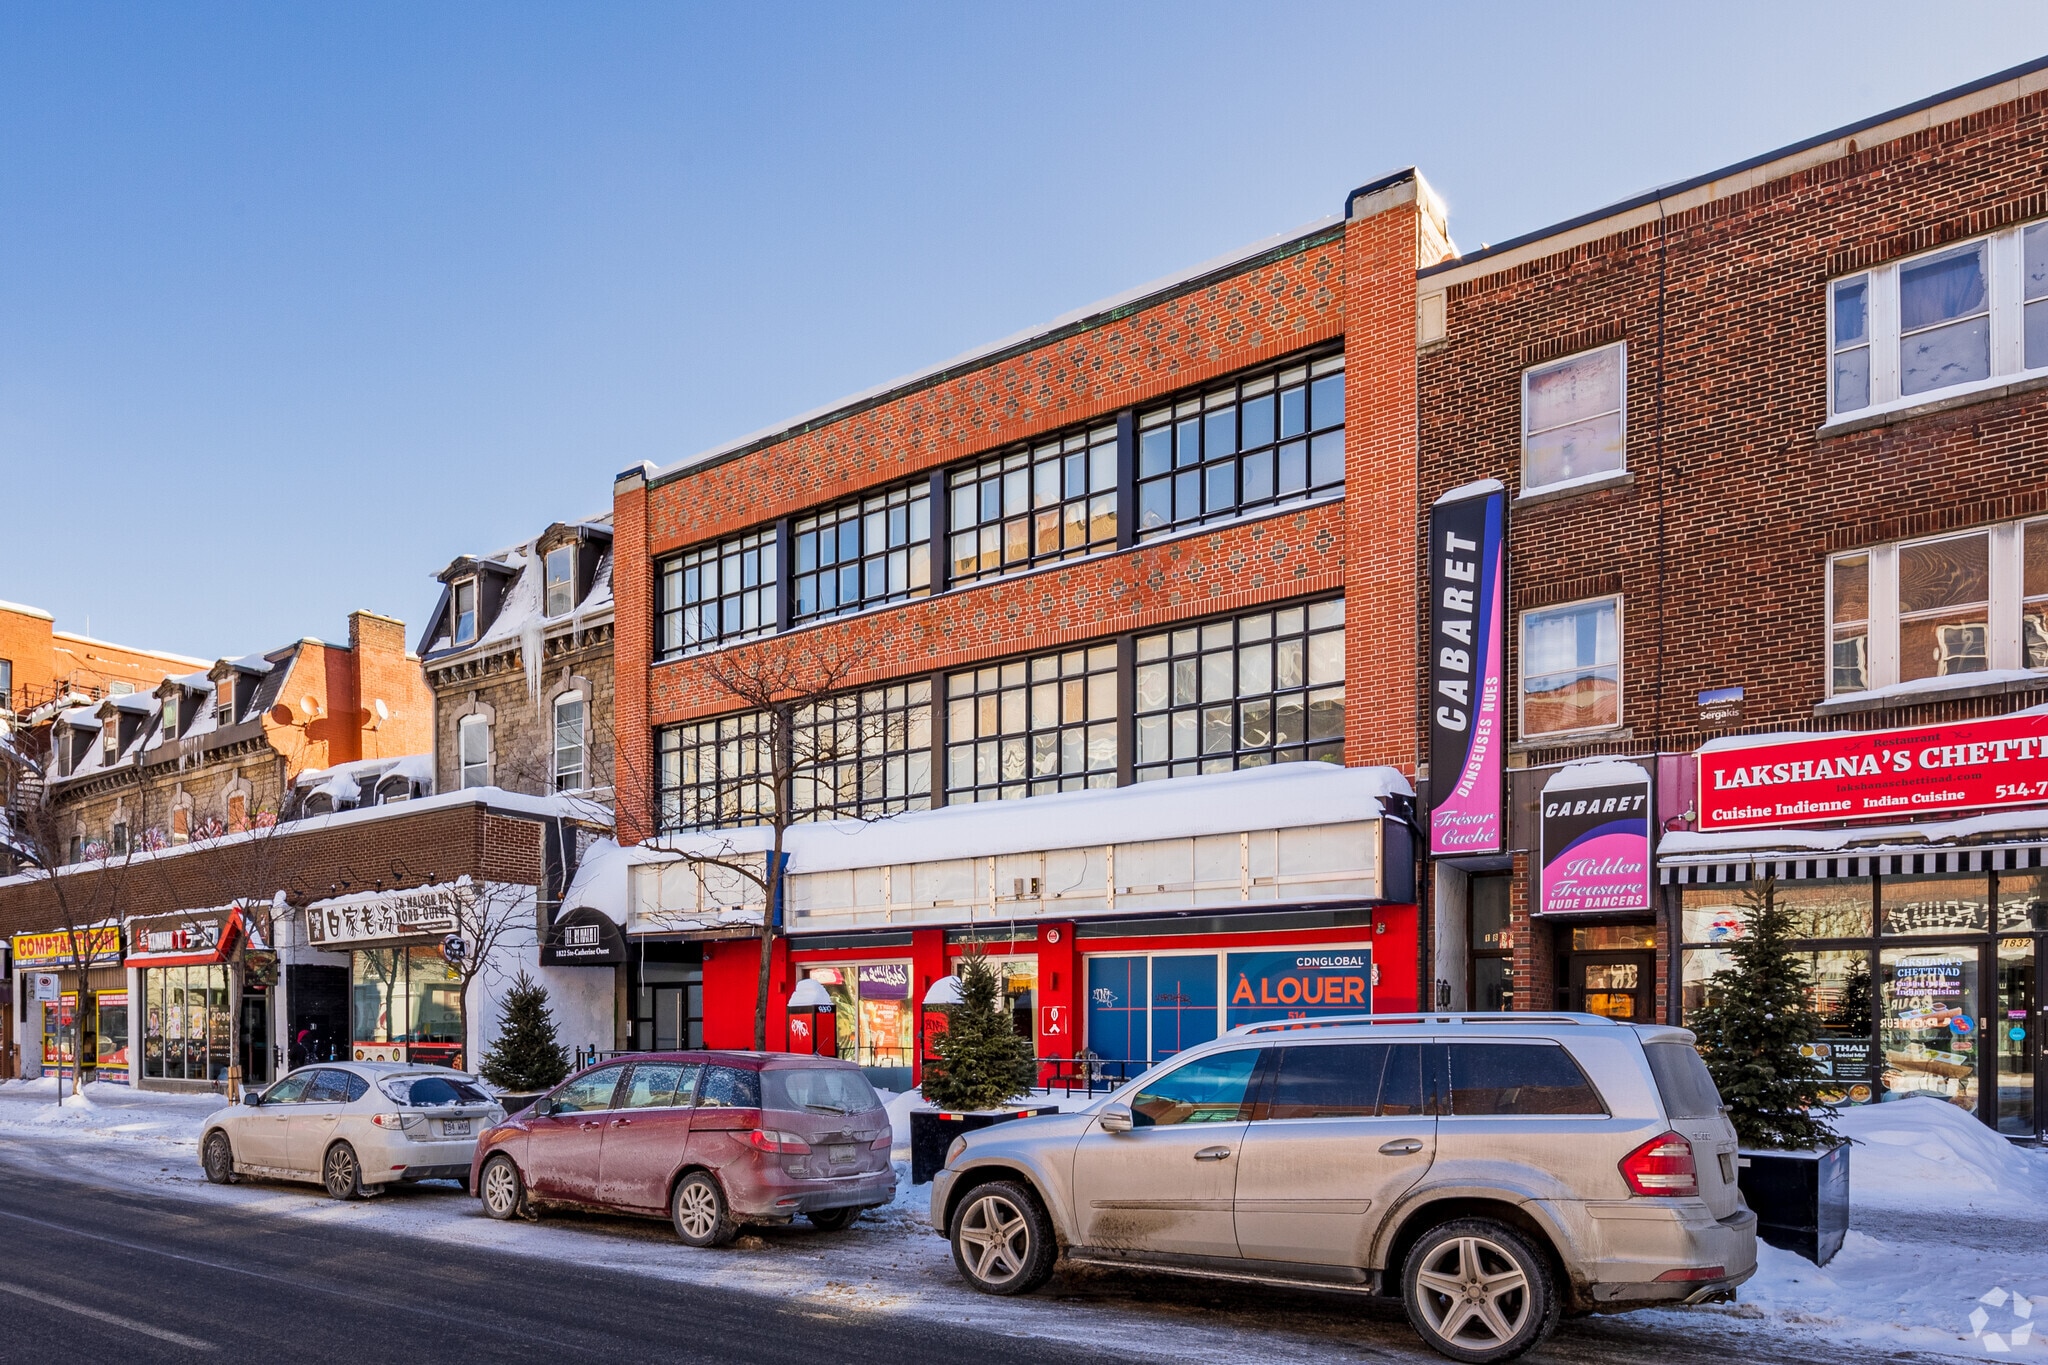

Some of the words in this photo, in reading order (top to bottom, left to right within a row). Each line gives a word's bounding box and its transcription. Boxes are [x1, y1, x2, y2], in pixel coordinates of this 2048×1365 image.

[1436, 531, 1476, 732] CABARET
[1700, 708, 1740, 720] Sergakis
[1457, 718, 1492, 798] DANSEUSES
[1482, 676, 1498, 712] NUES
[1873, 733, 1941, 748] Restaurant
[1713, 749, 1912, 790] LAKSHANA'S
[1836, 773, 1982, 793] lakshanaschettinad.com
[1545, 795, 1645, 818] CABARET
[1863, 795, 1909, 808] Indian
[1911, 790, 1965, 804] Cuisine
[1433, 810, 1496, 828] Trésor
[1712, 805, 1772, 821] Cuisine
[1775, 799, 1852, 816] Indienne
[1441, 826, 1496, 847] Caché
[1563, 857, 1643, 878] Hidden
[1551, 880, 1643, 898] Treasure
[1547, 898, 1581, 910] NUDE
[1584, 894, 1644, 908] DANCERS
[596, 947, 610, 955] Ouest
[2002, 938, 2031, 948] 1832
[1296, 956, 1364, 966] CDNGLOBAL
[1895, 956, 1963, 968] LAKSHANA'S
[1897, 967, 1961, 977] CHETTINAD
[1232, 972, 1256, 1004] À
[1261, 976, 1366, 1004] LOUER
[1833, 1044, 1870, 1052] THALI
